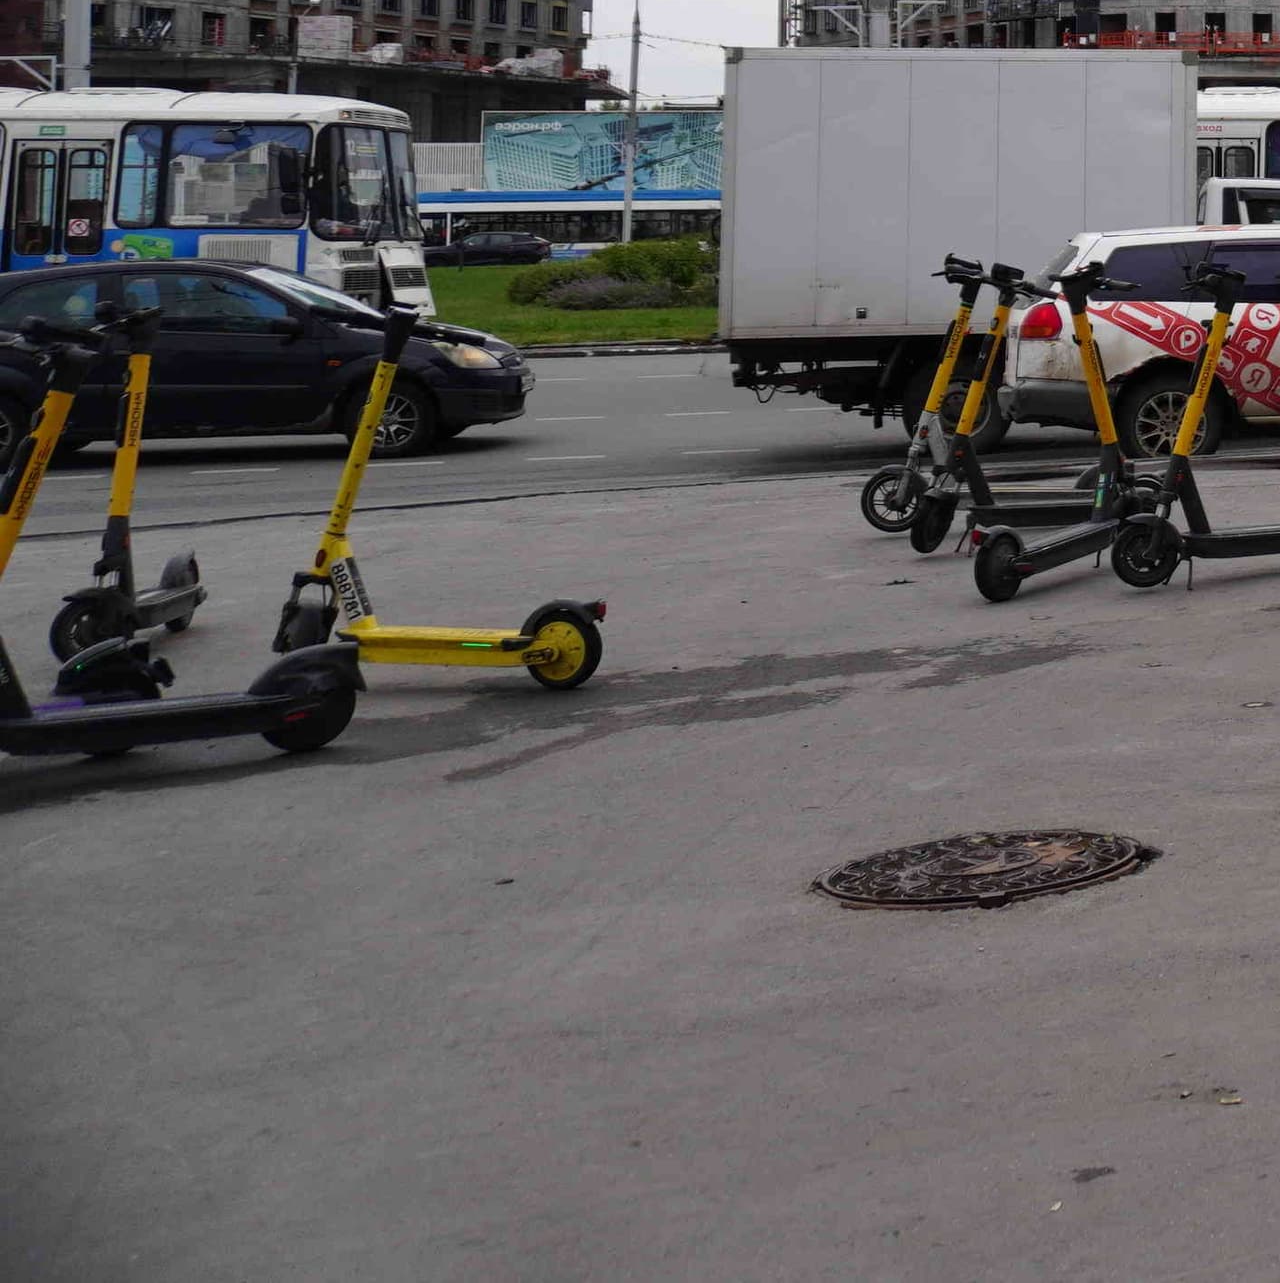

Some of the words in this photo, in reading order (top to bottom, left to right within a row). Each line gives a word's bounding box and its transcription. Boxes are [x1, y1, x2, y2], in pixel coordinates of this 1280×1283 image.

[129, 391, 145, 446] WHOOSH
[12, 461, 44, 521] WHOOSH
[331, 563, 361, 620] 888781
